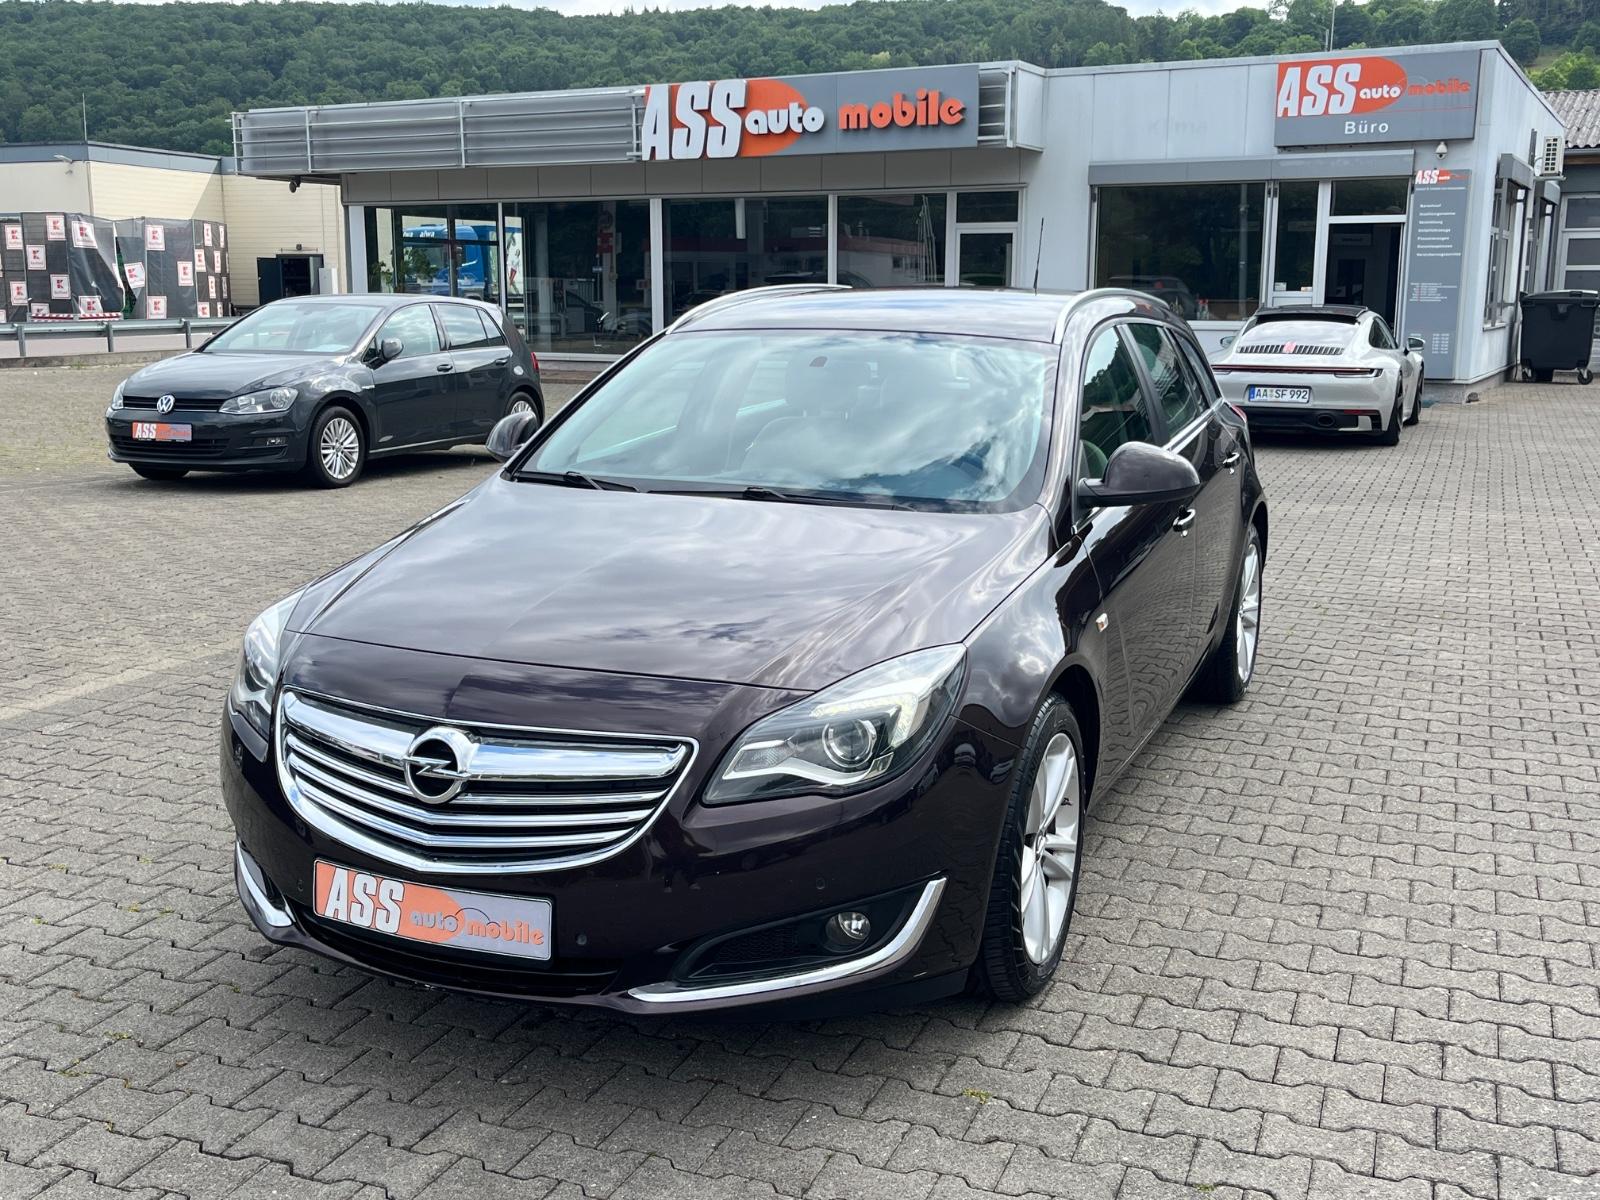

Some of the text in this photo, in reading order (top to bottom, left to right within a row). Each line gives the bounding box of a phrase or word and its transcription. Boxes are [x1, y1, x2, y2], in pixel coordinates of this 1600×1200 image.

[1277, 63, 1471, 117] ASS auto mobile
[642, 79, 966, 161] ASS auto mobile
[1344, 120, 1389, 135] Büro
[1415, 169, 1439, 184] ASS
[1256, 389, 1308, 400] AA SF 992
[135, 423, 157, 439] ASS
[324, 867, 544, 945] ASS auto mobile
